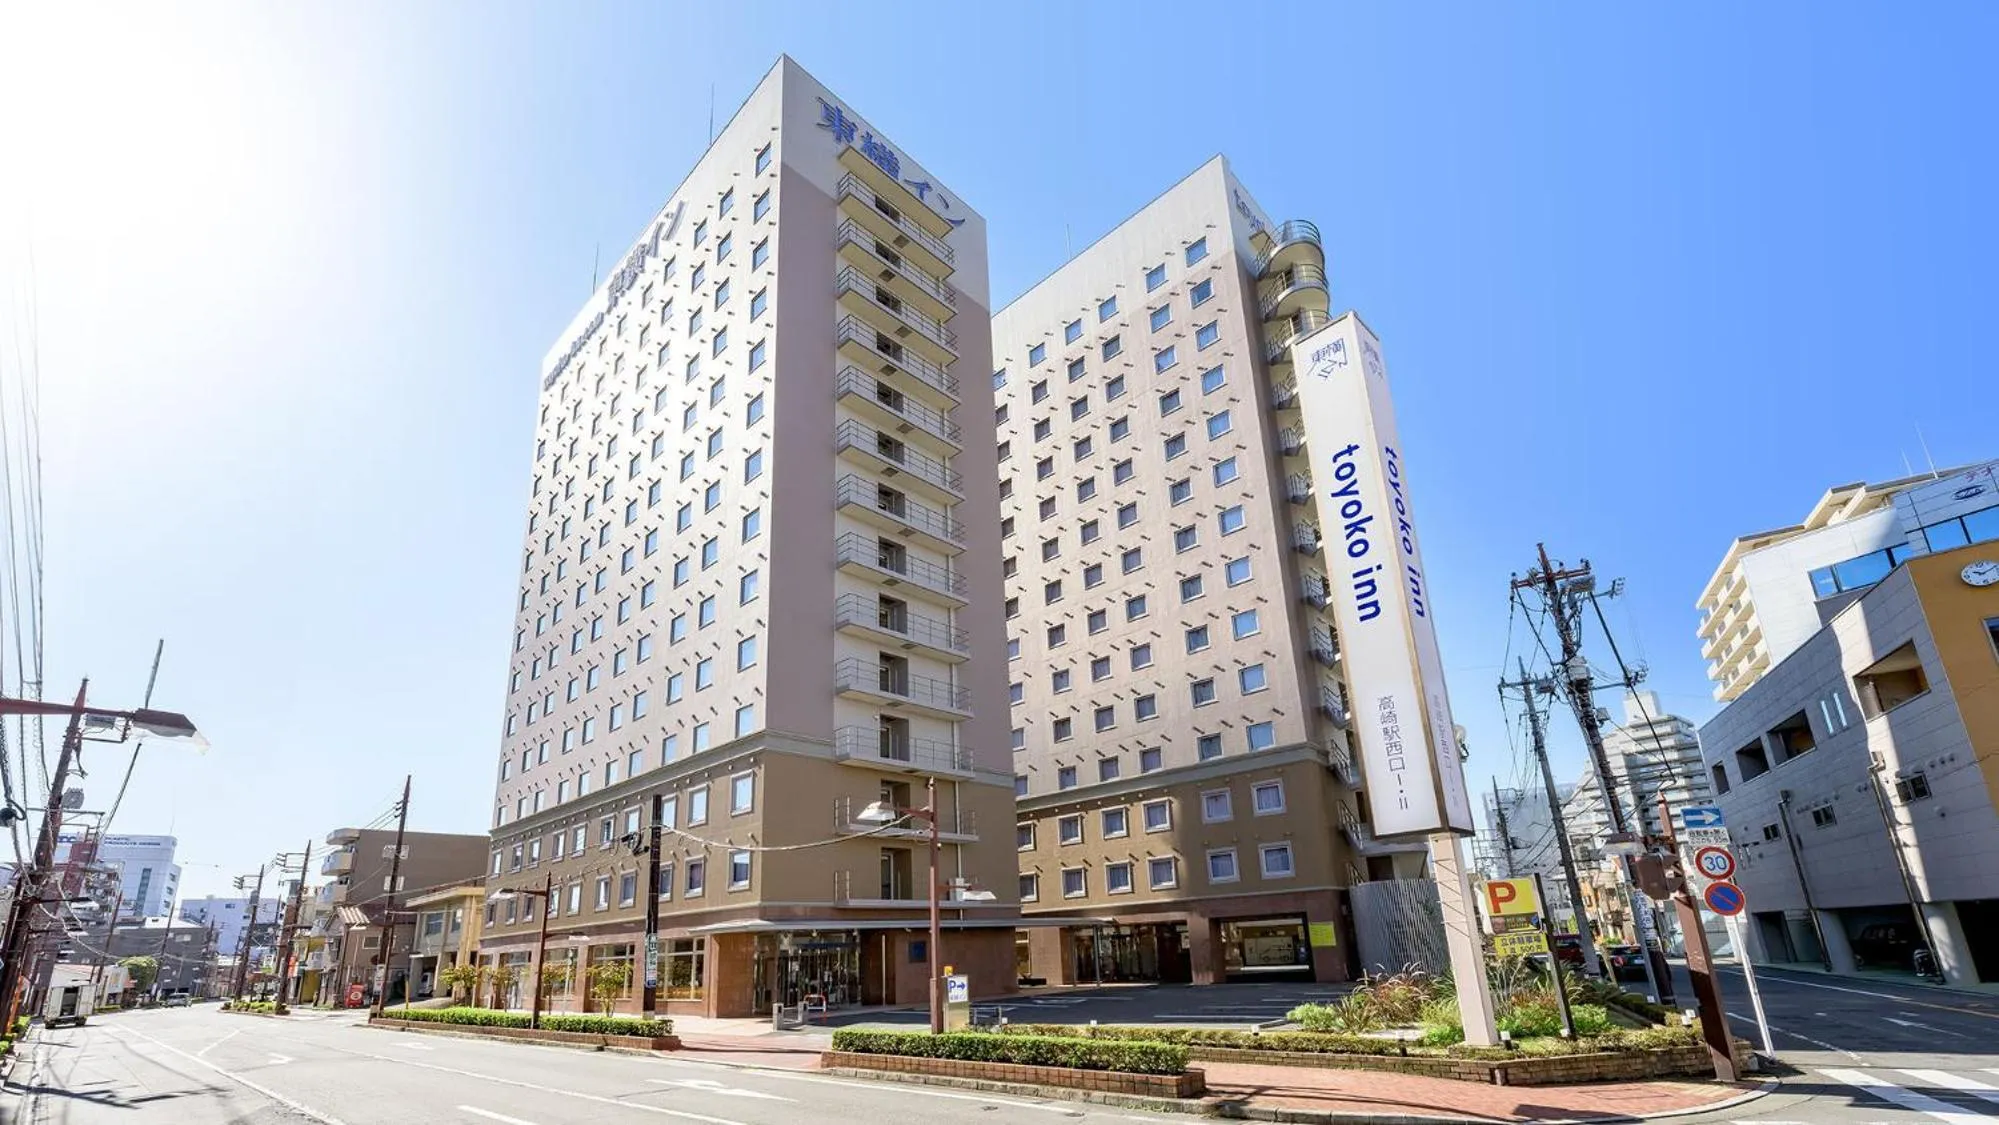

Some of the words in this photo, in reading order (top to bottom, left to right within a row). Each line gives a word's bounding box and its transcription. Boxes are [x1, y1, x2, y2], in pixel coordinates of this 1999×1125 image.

[815, 97, 965, 226] 東横イン
[1331, 444, 1374, 559] toyoko
[1385, 446, 1414, 556] toyoko
[1407, 564, 1426, 618] inn
[1352, 564, 1383, 622] inn
[1704, 855, 1727, 872] 30
[1487, 881, 1517, 914] P
[949, 980, 957, 993] P
